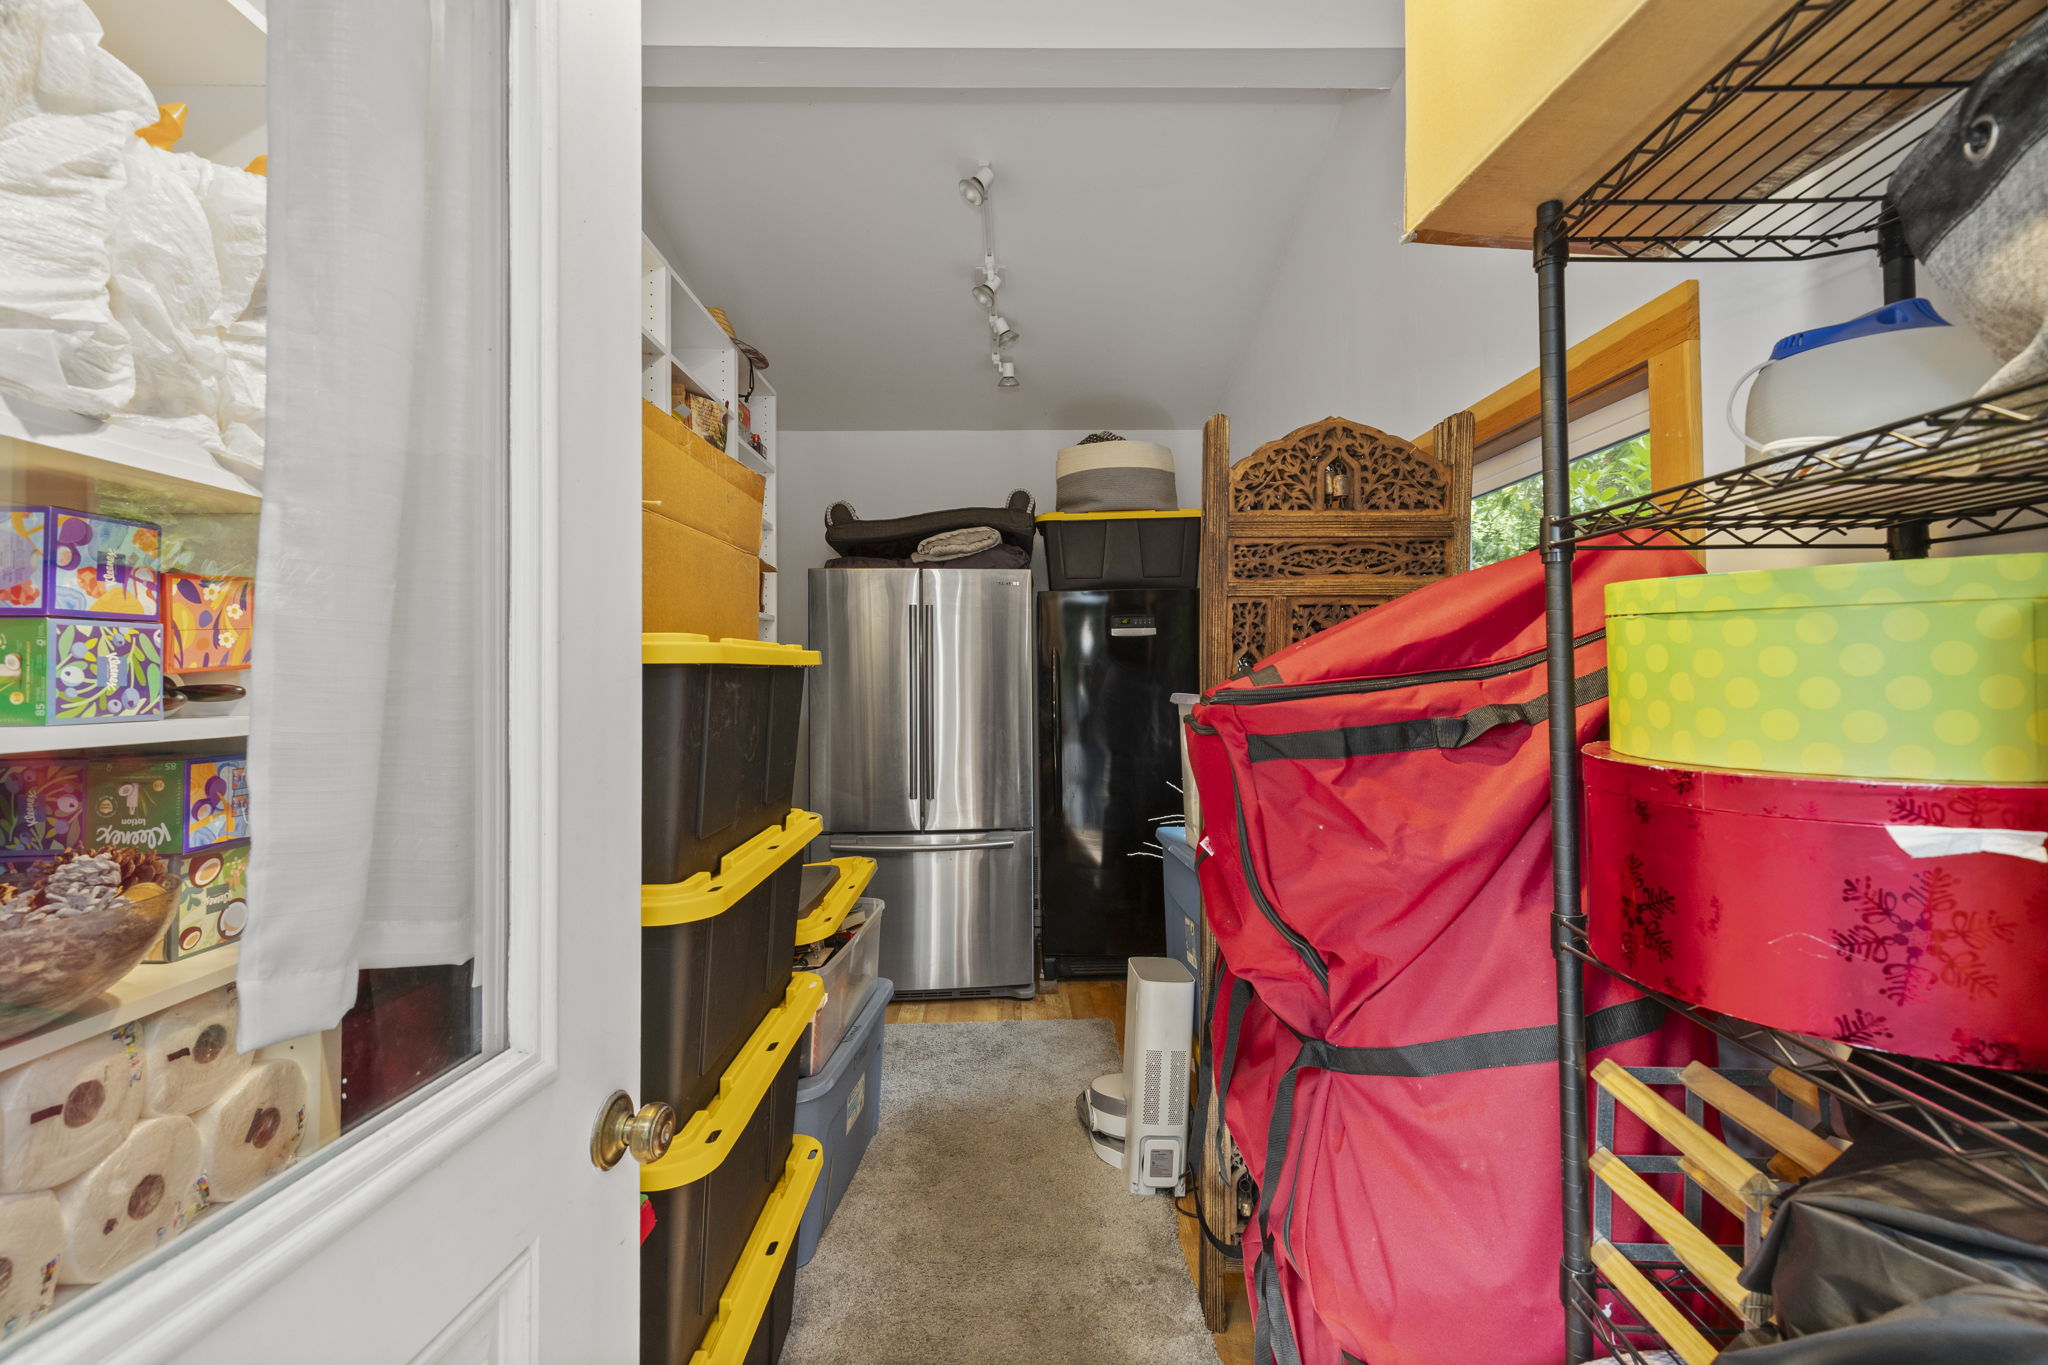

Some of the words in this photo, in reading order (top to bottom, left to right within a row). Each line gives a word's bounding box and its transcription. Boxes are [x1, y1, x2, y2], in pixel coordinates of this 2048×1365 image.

[35, 703, 45, 716] 85
[121, 818, 146, 827] lotion
[96, 822, 172, 849] Kleenex
